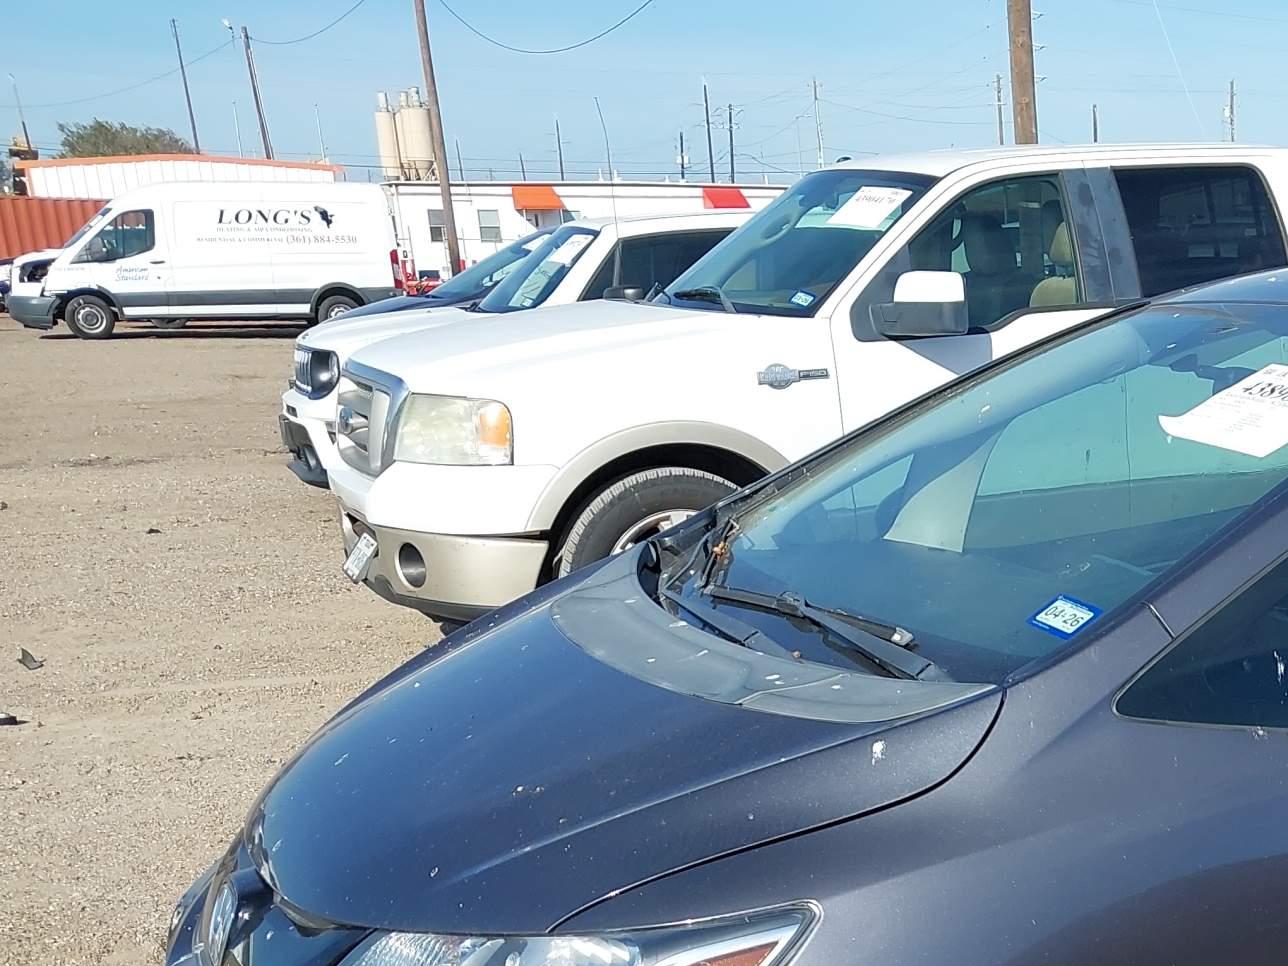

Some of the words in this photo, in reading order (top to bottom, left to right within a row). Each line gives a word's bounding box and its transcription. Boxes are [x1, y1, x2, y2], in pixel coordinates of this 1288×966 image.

[217, 208, 312, 226] LONG'S
[286, 235, 312, 245] (361)
[314, 235, 358, 244] 884-5530
